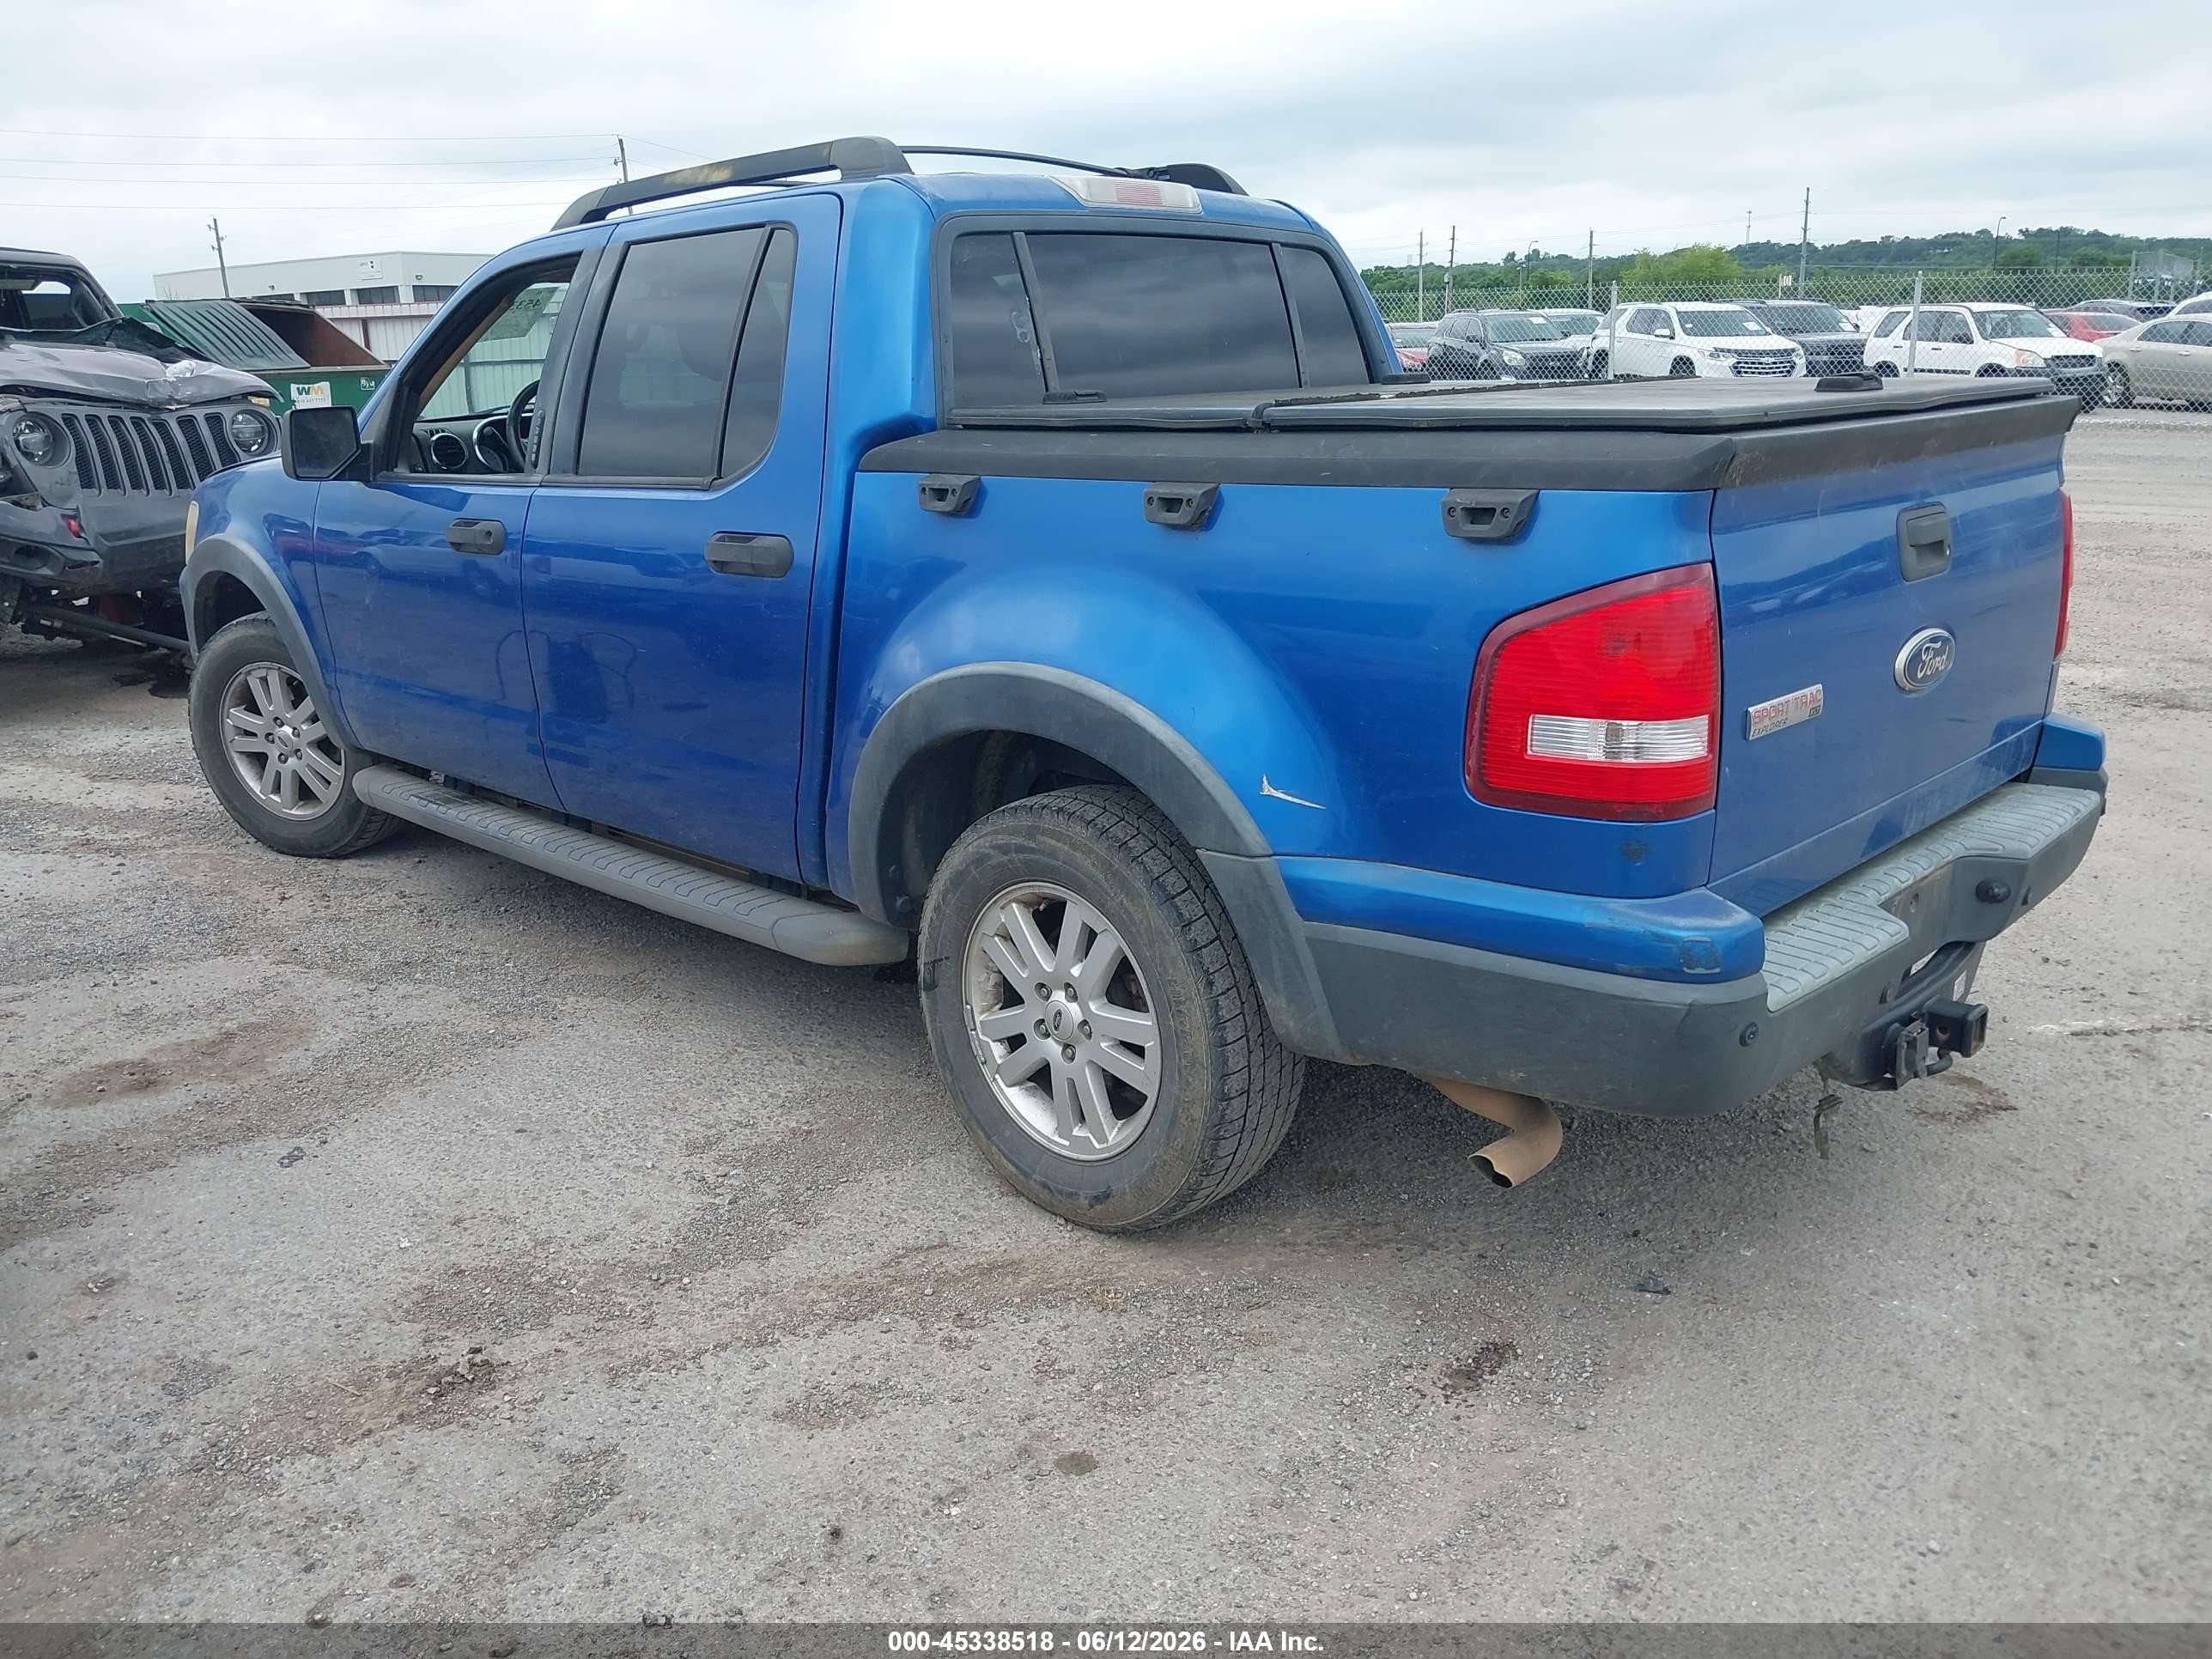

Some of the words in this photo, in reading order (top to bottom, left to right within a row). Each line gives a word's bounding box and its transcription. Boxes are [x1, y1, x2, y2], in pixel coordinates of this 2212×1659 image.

[296, 385, 324, 396] WM
[1917, 641, 1948, 678] Ford
[1753, 700, 1790, 724] SPORT
[1792, 690, 1822, 710] TRAC
[1752, 718, 1789, 737] EXPLORER
